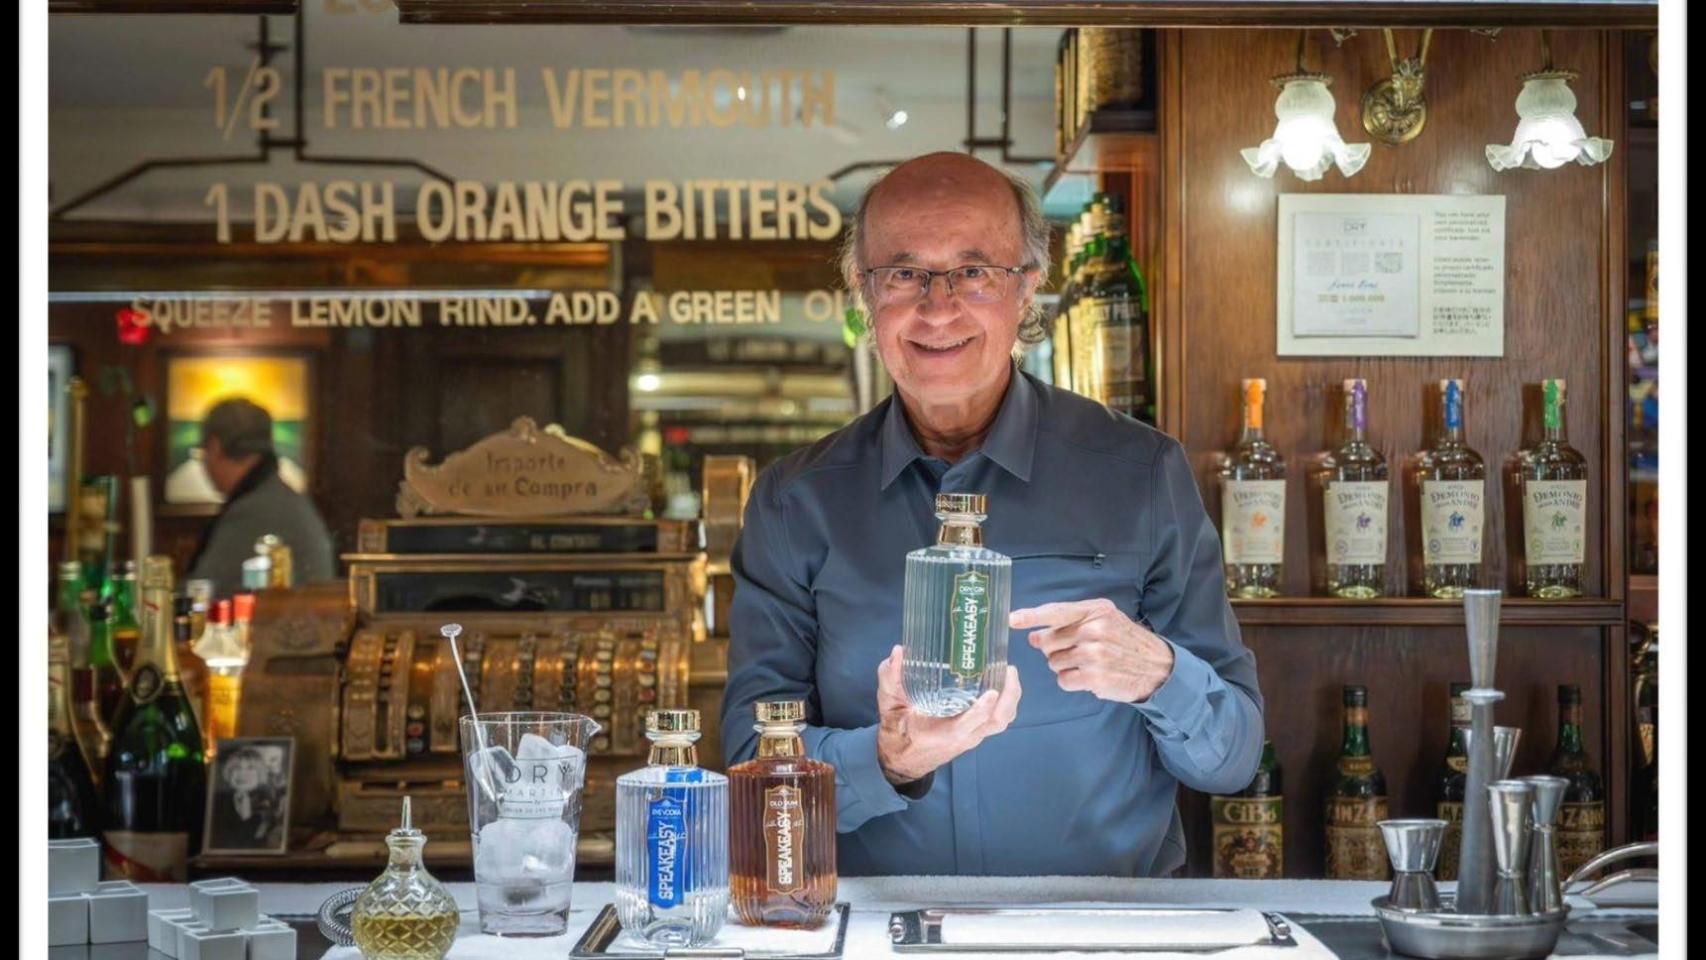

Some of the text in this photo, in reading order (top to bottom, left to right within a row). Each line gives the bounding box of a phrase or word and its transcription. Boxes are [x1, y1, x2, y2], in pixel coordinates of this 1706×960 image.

[204, 56, 838, 141] 1/2 FRENCH VERMOUTH
[204, 179, 843, 243] 1 DASH ORANGE BITTERS
[130, 296, 271, 332] SQUEEZE
[291, 297, 421, 327] LEMON
[439, 293, 537, 326] RIND.
[545, 291, 620, 325] ADD
[630, 291, 659, 324] A
[668, 290, 781, 323] GREEN
[514, 477, 598, 500] Compra
[961, 597, 979, 670] SPEAKEASY
[504, 762, 572, 784] DRY
[658, 820, 677, 901] SPEAKEASY
[776, 810, 793, 885] SPEAKEASY
